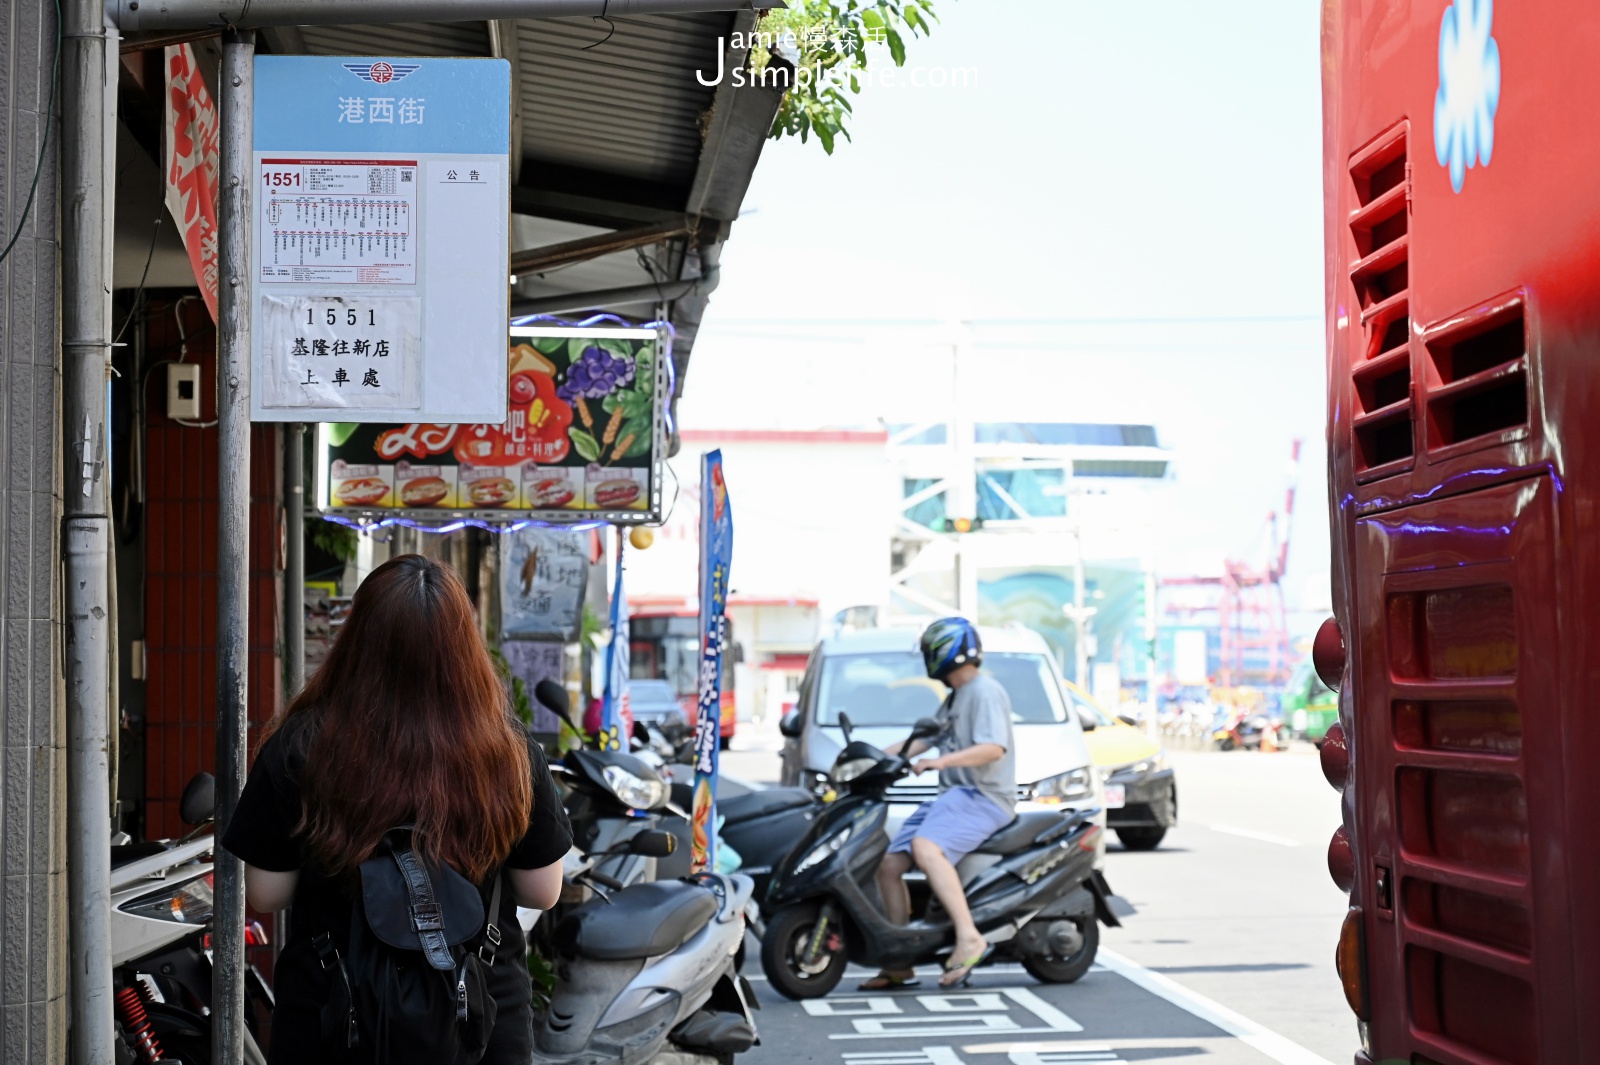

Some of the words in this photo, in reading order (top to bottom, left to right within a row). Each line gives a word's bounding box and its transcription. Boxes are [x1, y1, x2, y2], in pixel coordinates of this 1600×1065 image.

[338, 96, 426, 125] 港西街
[263, 172, 300, 186] 1551
[446, 169, 481, 181] 公告
[306, 307, 377, 326] 1551
[290, 338, 390, 357] 基隆往新店
[300, 367, 381, 388] 上車處
